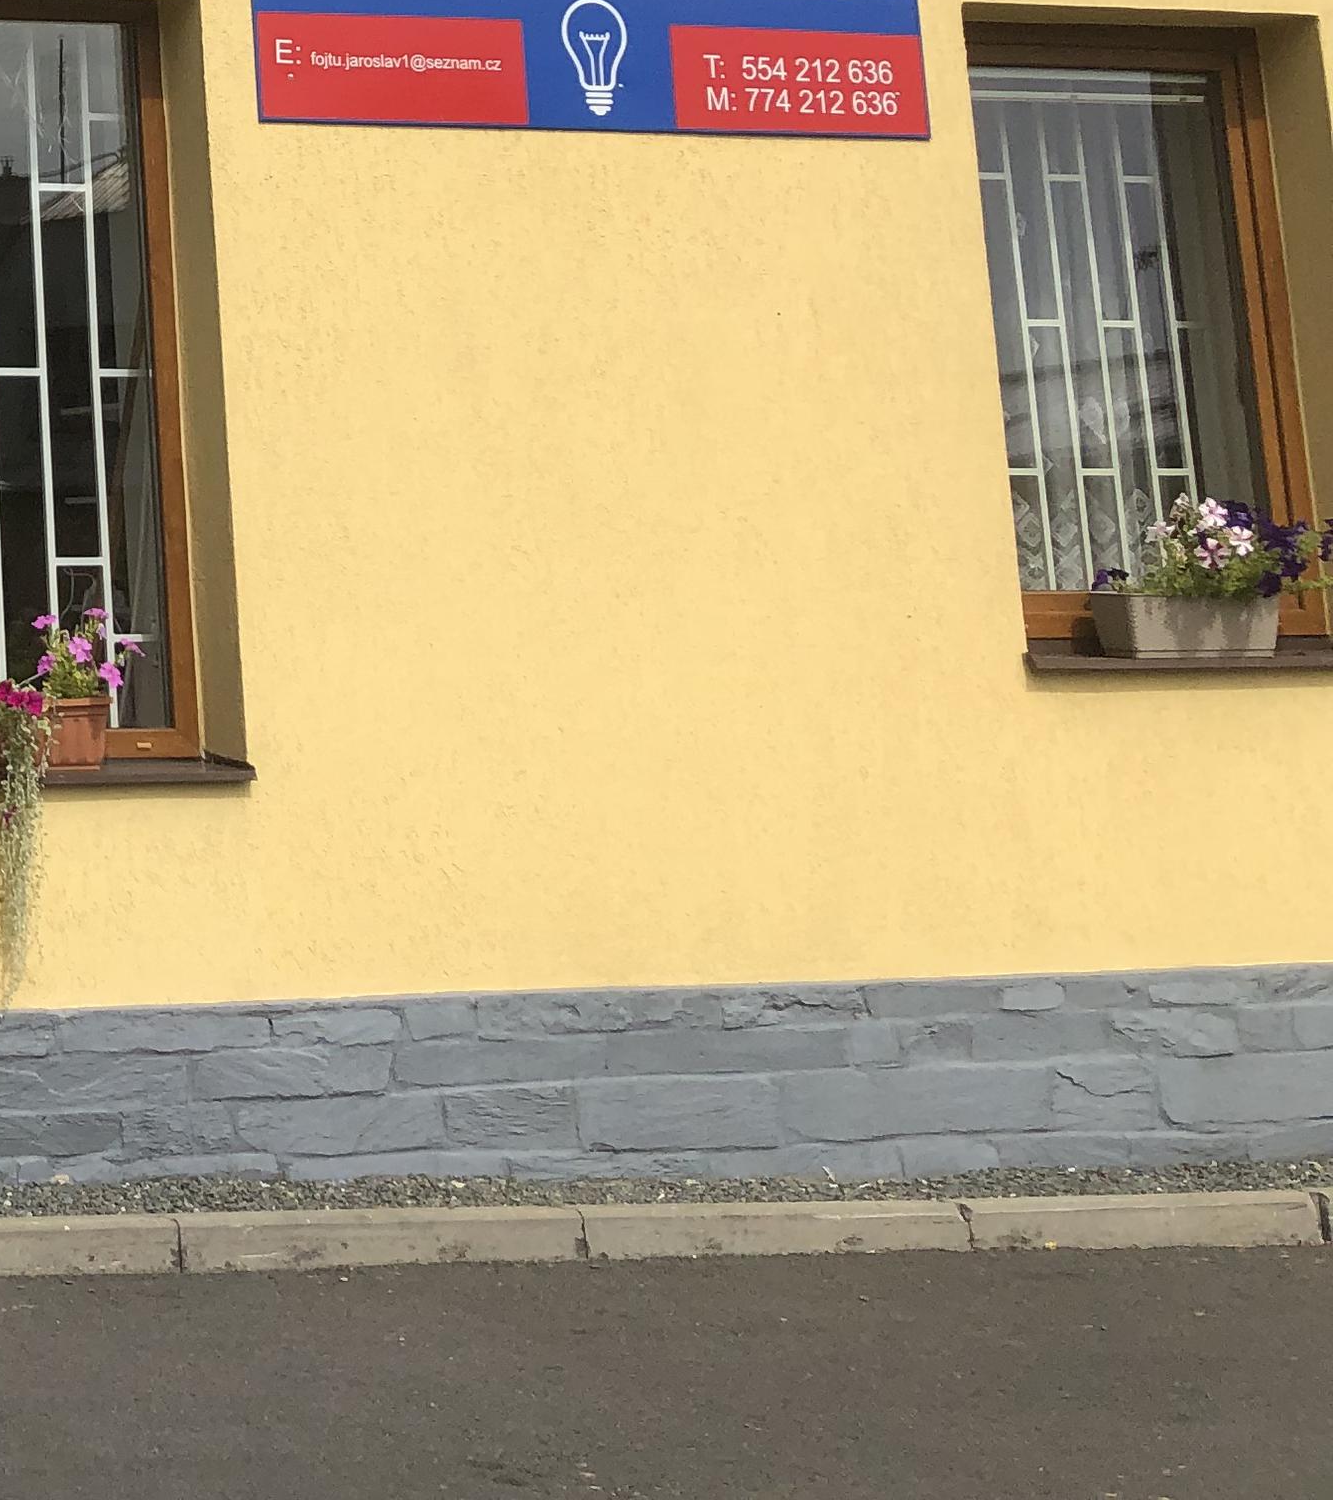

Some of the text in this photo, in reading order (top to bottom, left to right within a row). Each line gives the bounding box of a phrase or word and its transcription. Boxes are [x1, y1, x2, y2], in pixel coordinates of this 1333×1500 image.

[275, 39, 502, 72] E: fojtu.jaroslav1@seznam.cz
[703, 54, 893, 84] T: 554 212 636
[706, 87, 898, 115] M: 774 212 636
